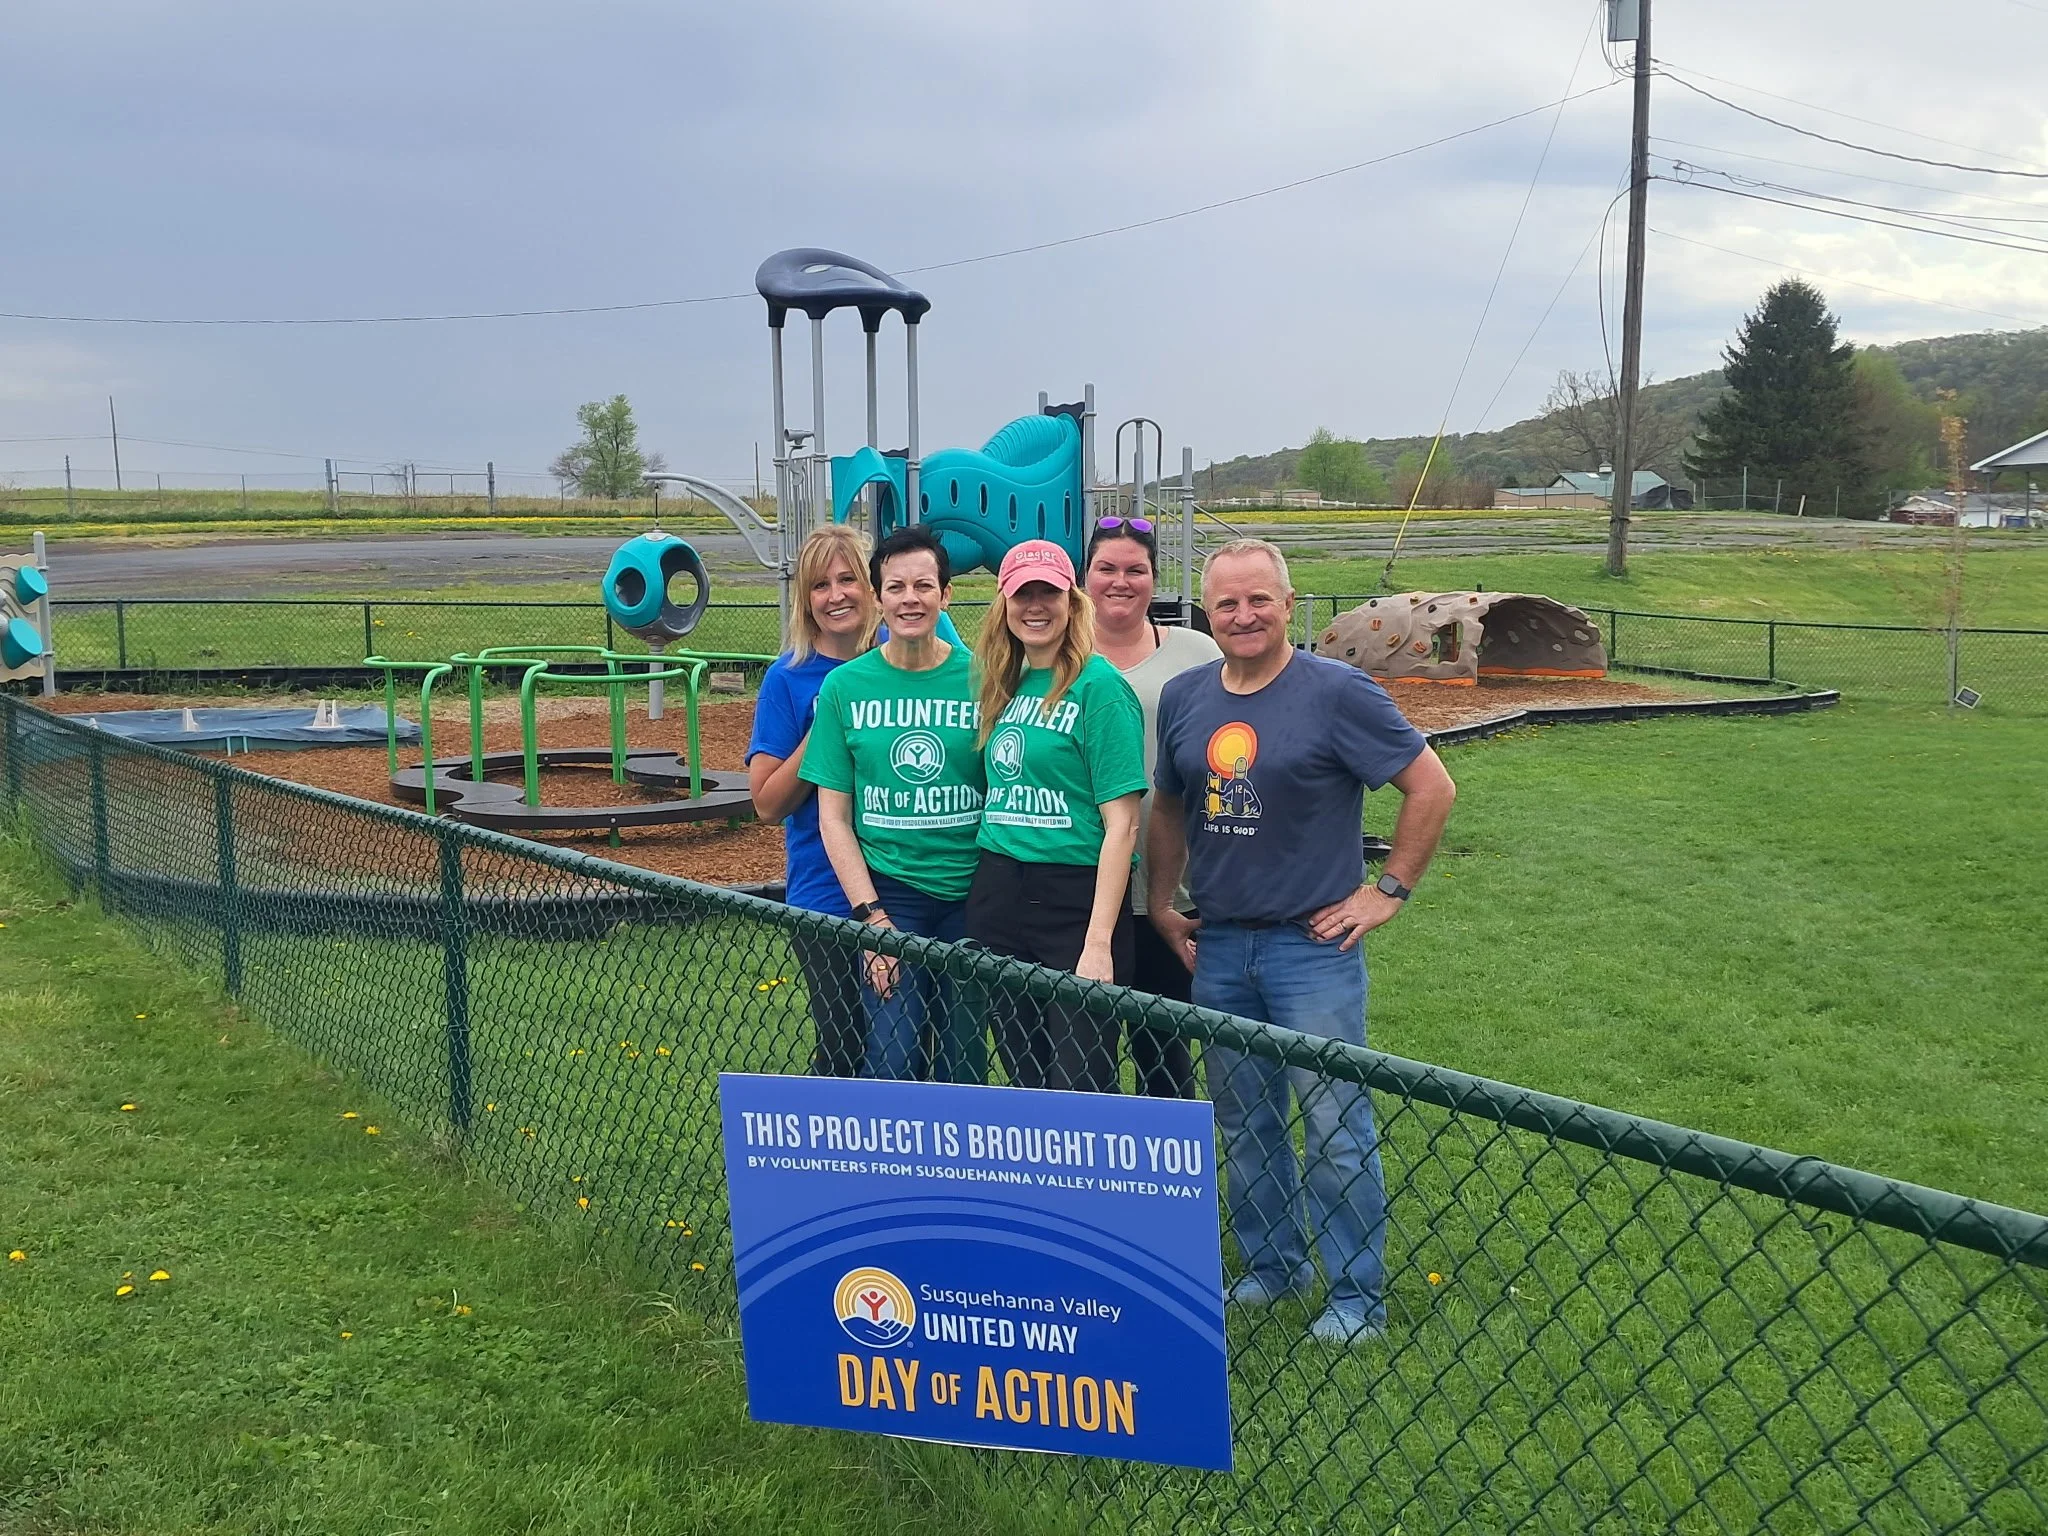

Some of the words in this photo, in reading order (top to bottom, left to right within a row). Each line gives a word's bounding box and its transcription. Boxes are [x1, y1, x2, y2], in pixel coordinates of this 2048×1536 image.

[864, 785, 889, 813] DAY
[895, 791, 910, 808] OF
[991, 787, 1005, 803] OF
[1005, 784, 1069, 814] ACTION
[1222, 825, 1231, 834] IS
[741, 1111, 801, 1148] THIS
[808, 1115, 925, 1155] PROJECT
[933, 1122, 960, 1157] IS
[967, 1123, 1096, 1167] BROUGHT
[1103, 1133, 1137, 1171] TO
[1145, 1136, 1203, 1176] YOU
[748, 1156, 767, 1168] BY
[770, 1157, 868, 1174] VOLUNTEERS
[871, 1162, 912, 1177] FROM
[916, 1165, 1033, 1185] SUSQUEHANNA
[1035, 1173, 1095, 1190] VALLEY
[1099, 1178, 1158, 1195] UNITED
[1162, 1184, 1203, 1199] WAY
[919, 1284, 1055, 1312] Susquehanna
[1060, 1296, 1122, 1323] Valley
[923, 1312, 1015, 1348] UNITED
[1021, 1321, 1079, 1354] WAY
[837, 1353, 920, 1412] DAY
[931, 1372, 962, 1405] OF
[975, 1365, 1136, 1436] ACTION
